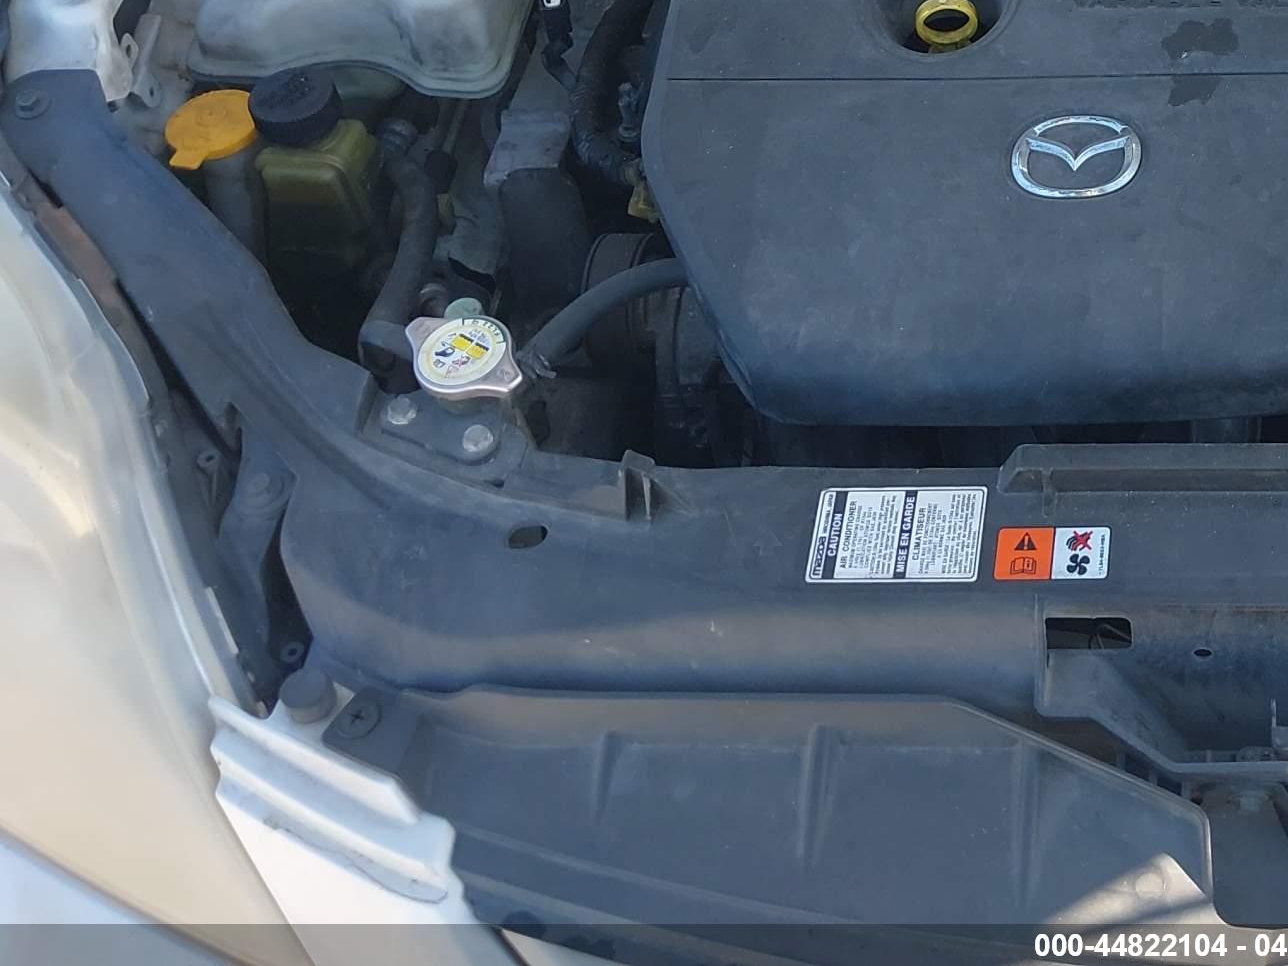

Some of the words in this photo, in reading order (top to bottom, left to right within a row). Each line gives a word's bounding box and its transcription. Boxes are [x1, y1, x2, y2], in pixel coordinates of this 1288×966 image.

[842, 499, 857, 552] CONDITIONER
[902, 496, 916, 530] GARDE
[827, 512, 843, 557] CAUTION
[900, 532, 910, 546] EN
[912, 507, 926, 561] CLIMATISEUR
[812, 535, 827, 577] mazda
[839, 554, 848, 569] AIR
[896, 548, 908, 573] MISE
